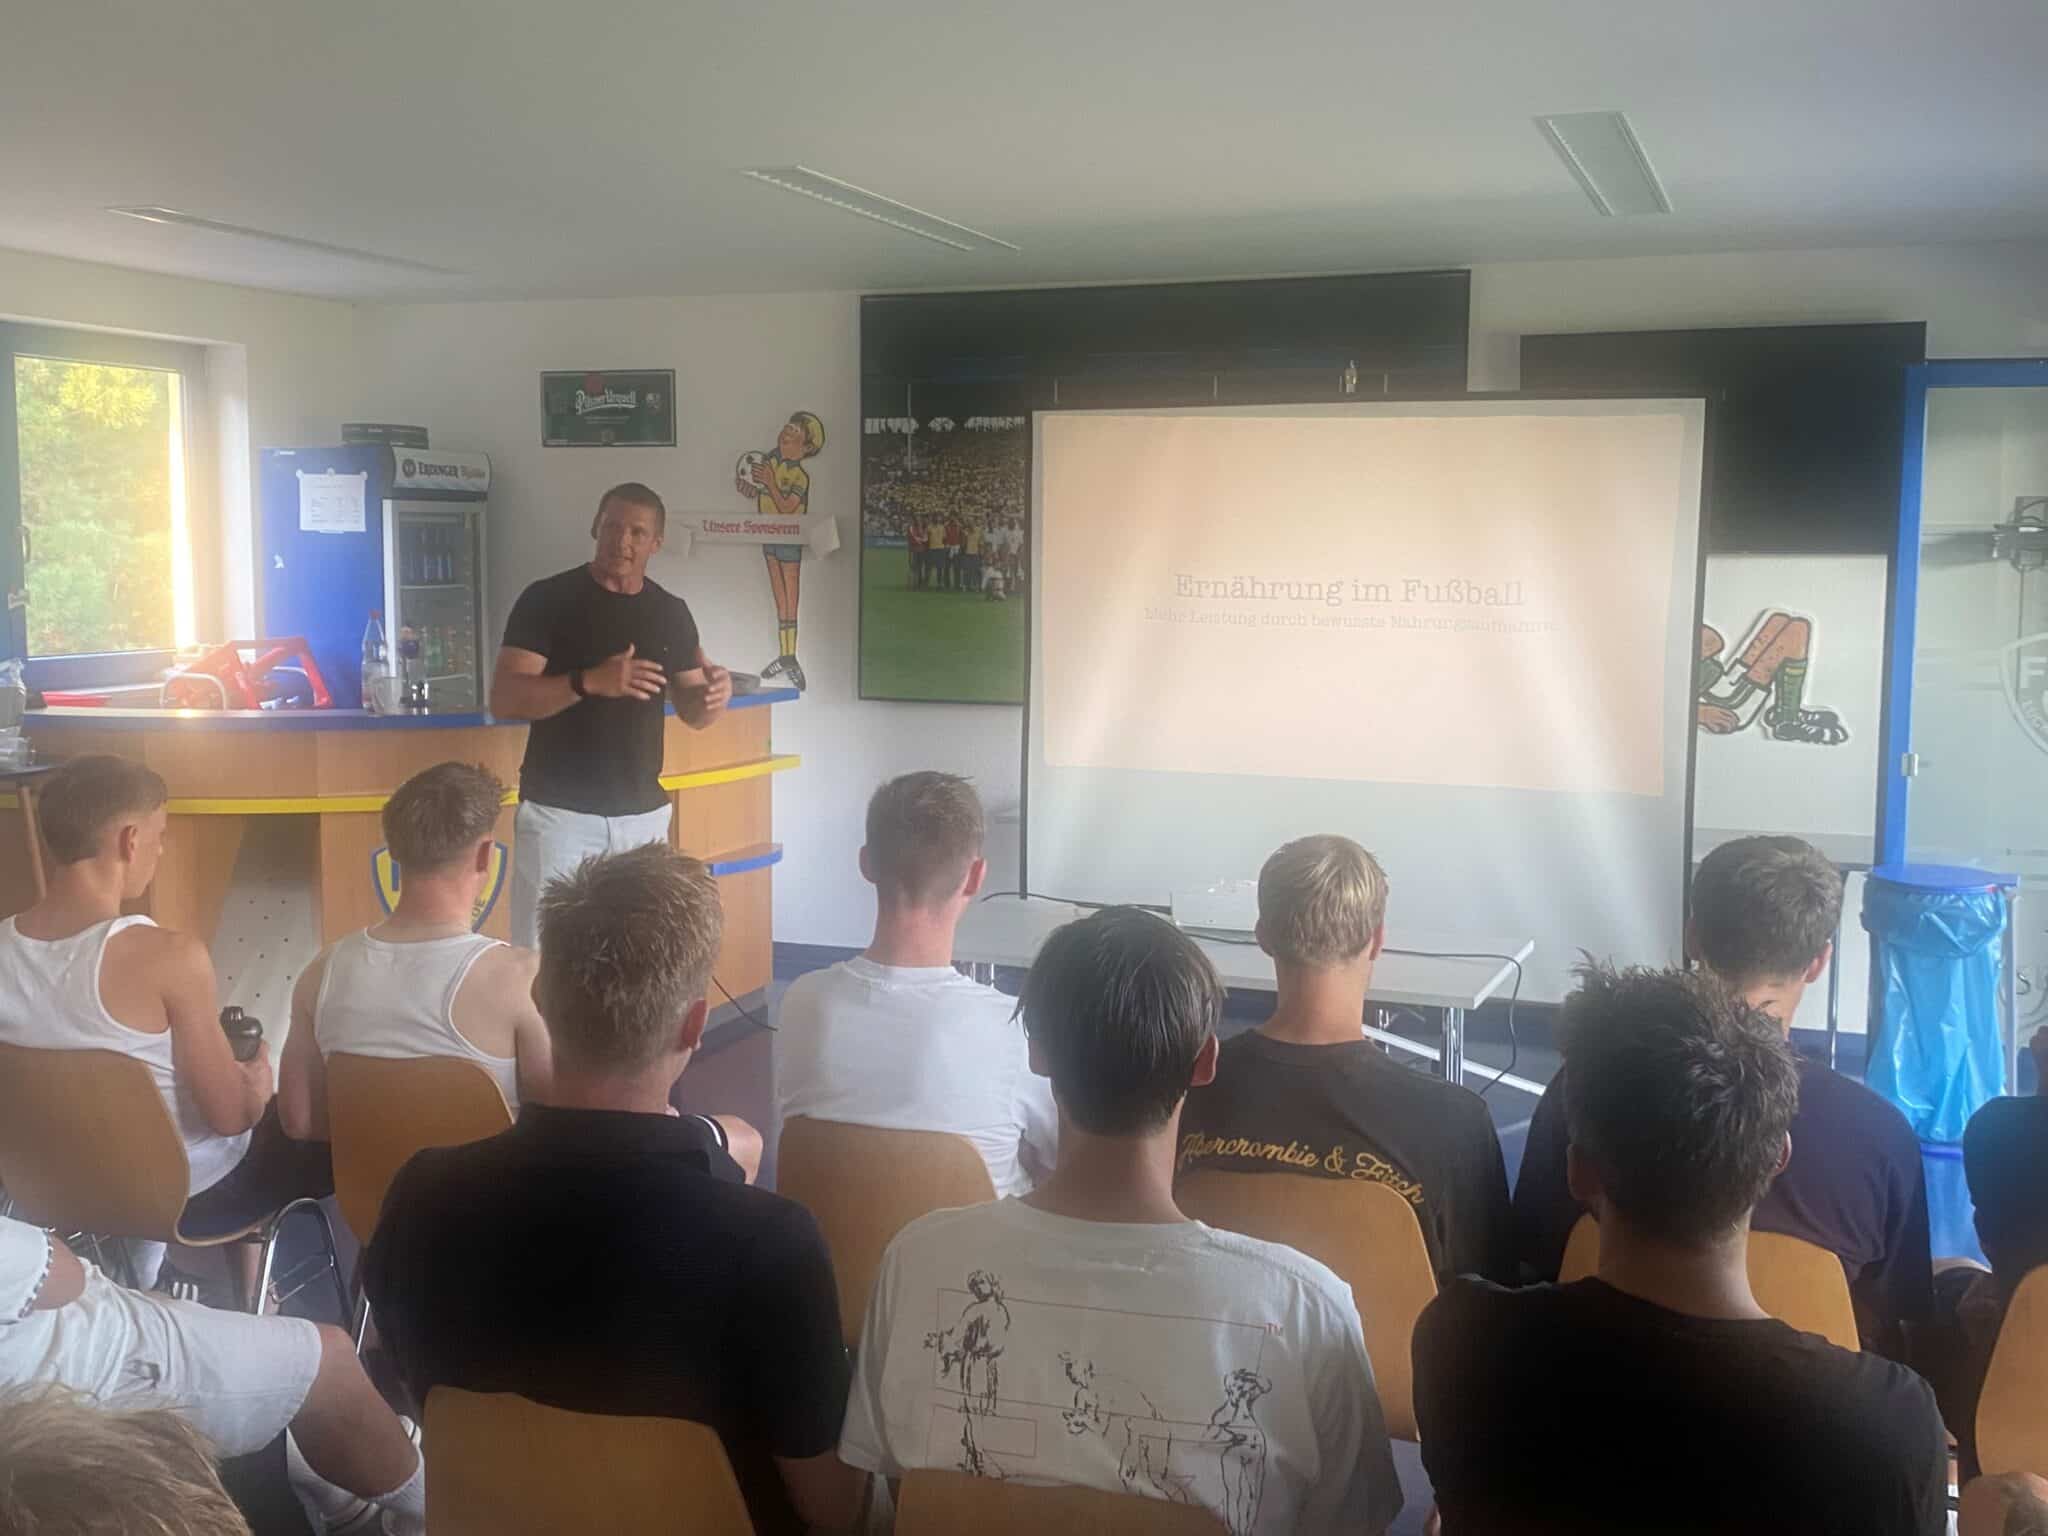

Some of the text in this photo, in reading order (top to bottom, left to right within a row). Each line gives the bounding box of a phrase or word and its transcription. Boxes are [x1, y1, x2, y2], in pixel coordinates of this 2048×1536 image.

[1175, 573, 1525, 607] Ernährung im Fußball
[1178, 1131, 1425, 1204] Abercrombie & Fitch
